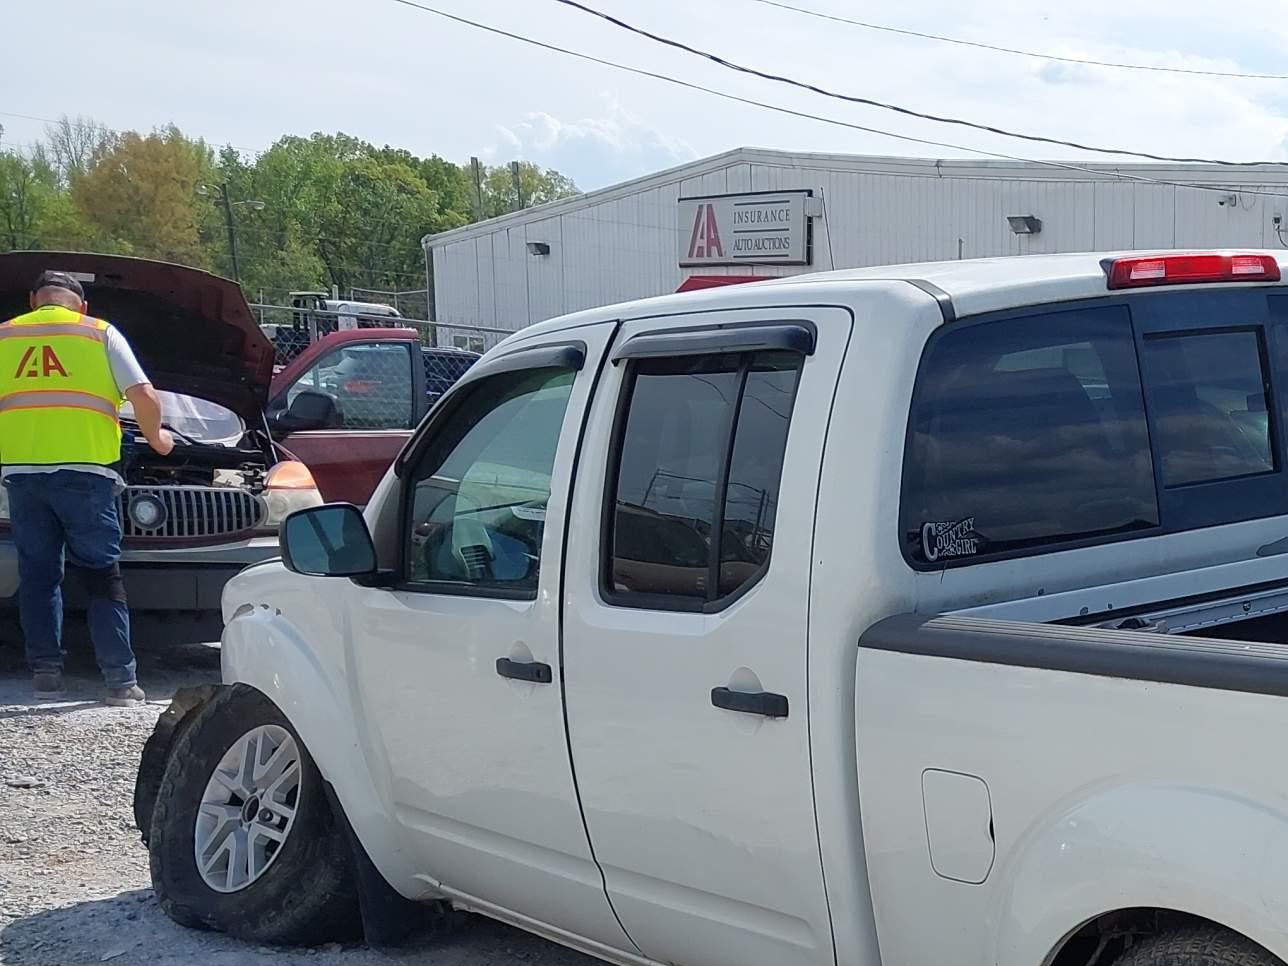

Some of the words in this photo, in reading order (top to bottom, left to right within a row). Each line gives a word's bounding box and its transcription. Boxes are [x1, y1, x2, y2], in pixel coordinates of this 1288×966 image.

[733, 208, 791, 225] INSURANCE
[733, 238, 750, 251] AUTO
[753, 236, 790, 251] AUCTIONS
[922, 517, 975, 561] COUNTRY
[955, 538, 977, 555] GIRL
